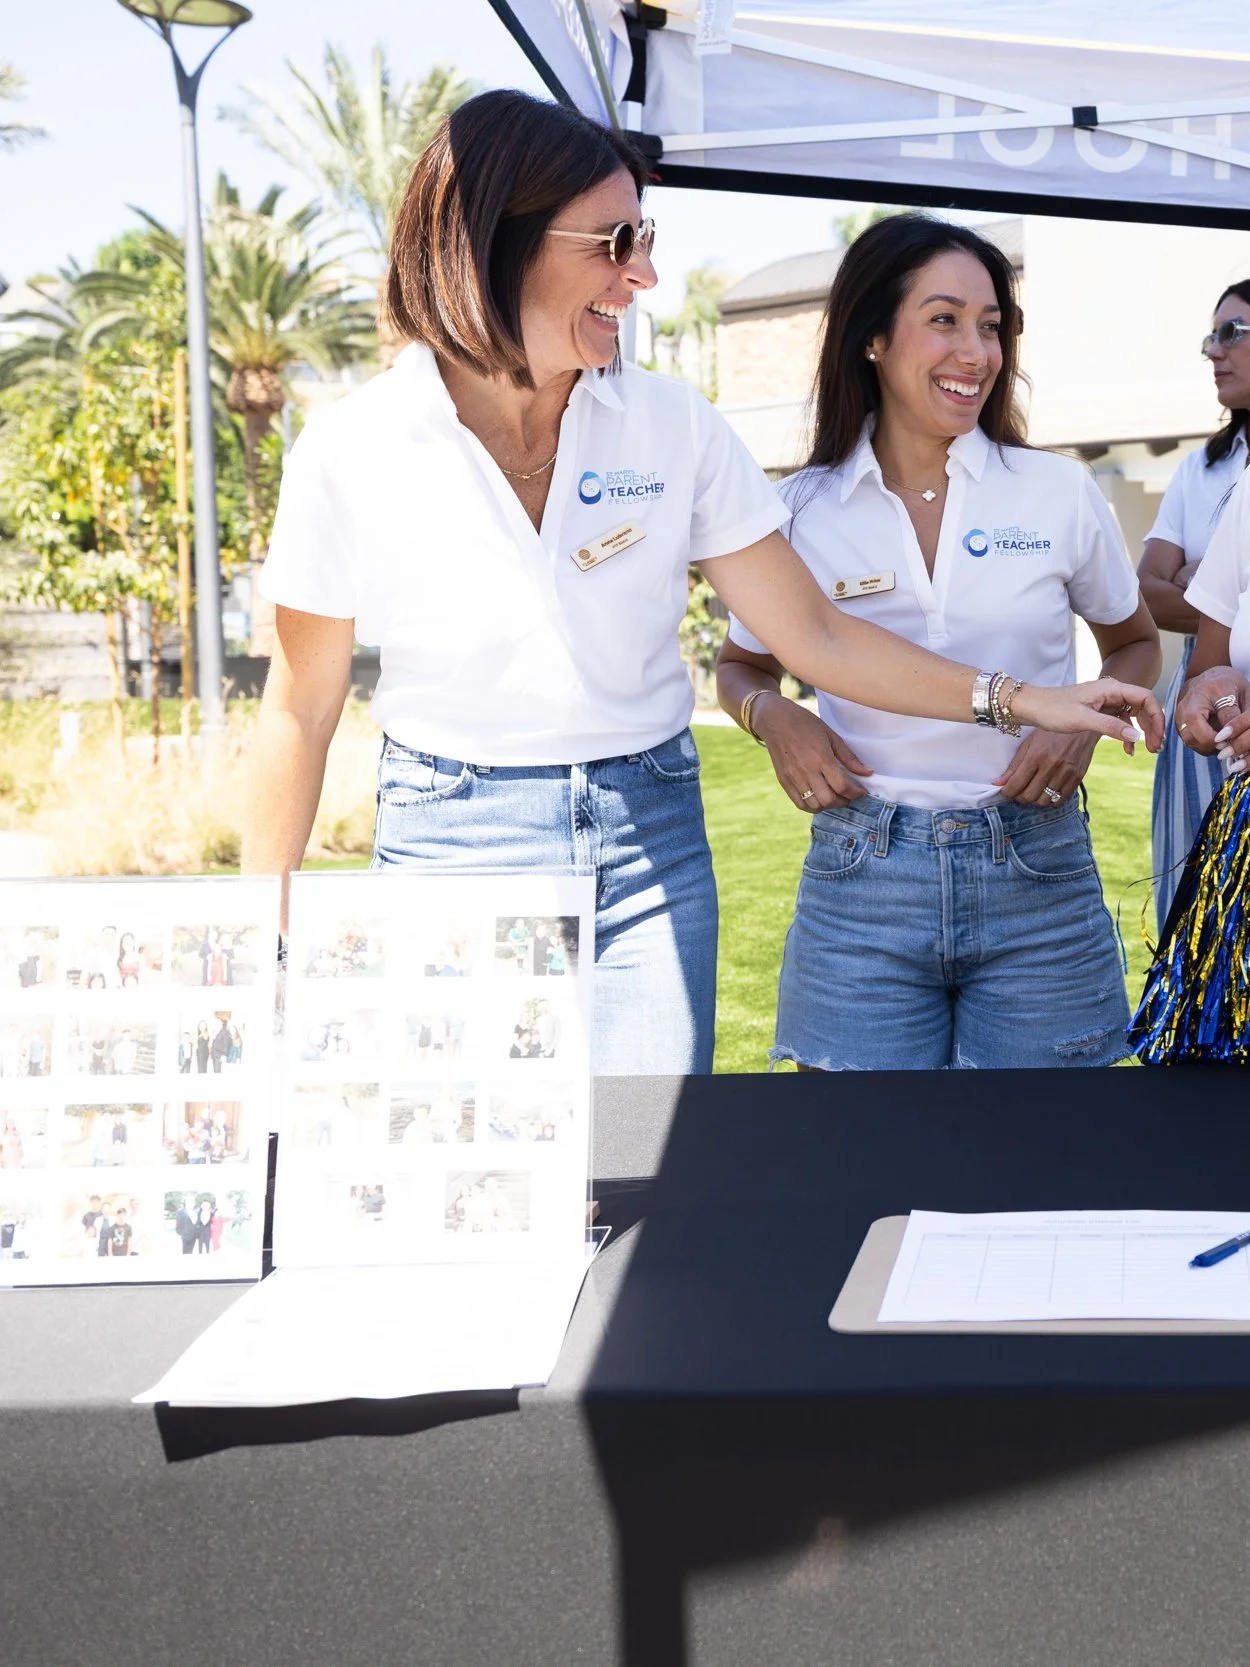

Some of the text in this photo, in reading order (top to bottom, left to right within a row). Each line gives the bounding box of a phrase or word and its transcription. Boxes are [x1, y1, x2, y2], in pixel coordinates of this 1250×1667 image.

[606, 471, 658, 487] PARENT
[607, 483, 665, 498] TEACHER
[993, 530, 1039, 541] PARENT
[995, 540, 1051, 550] TEACHER
